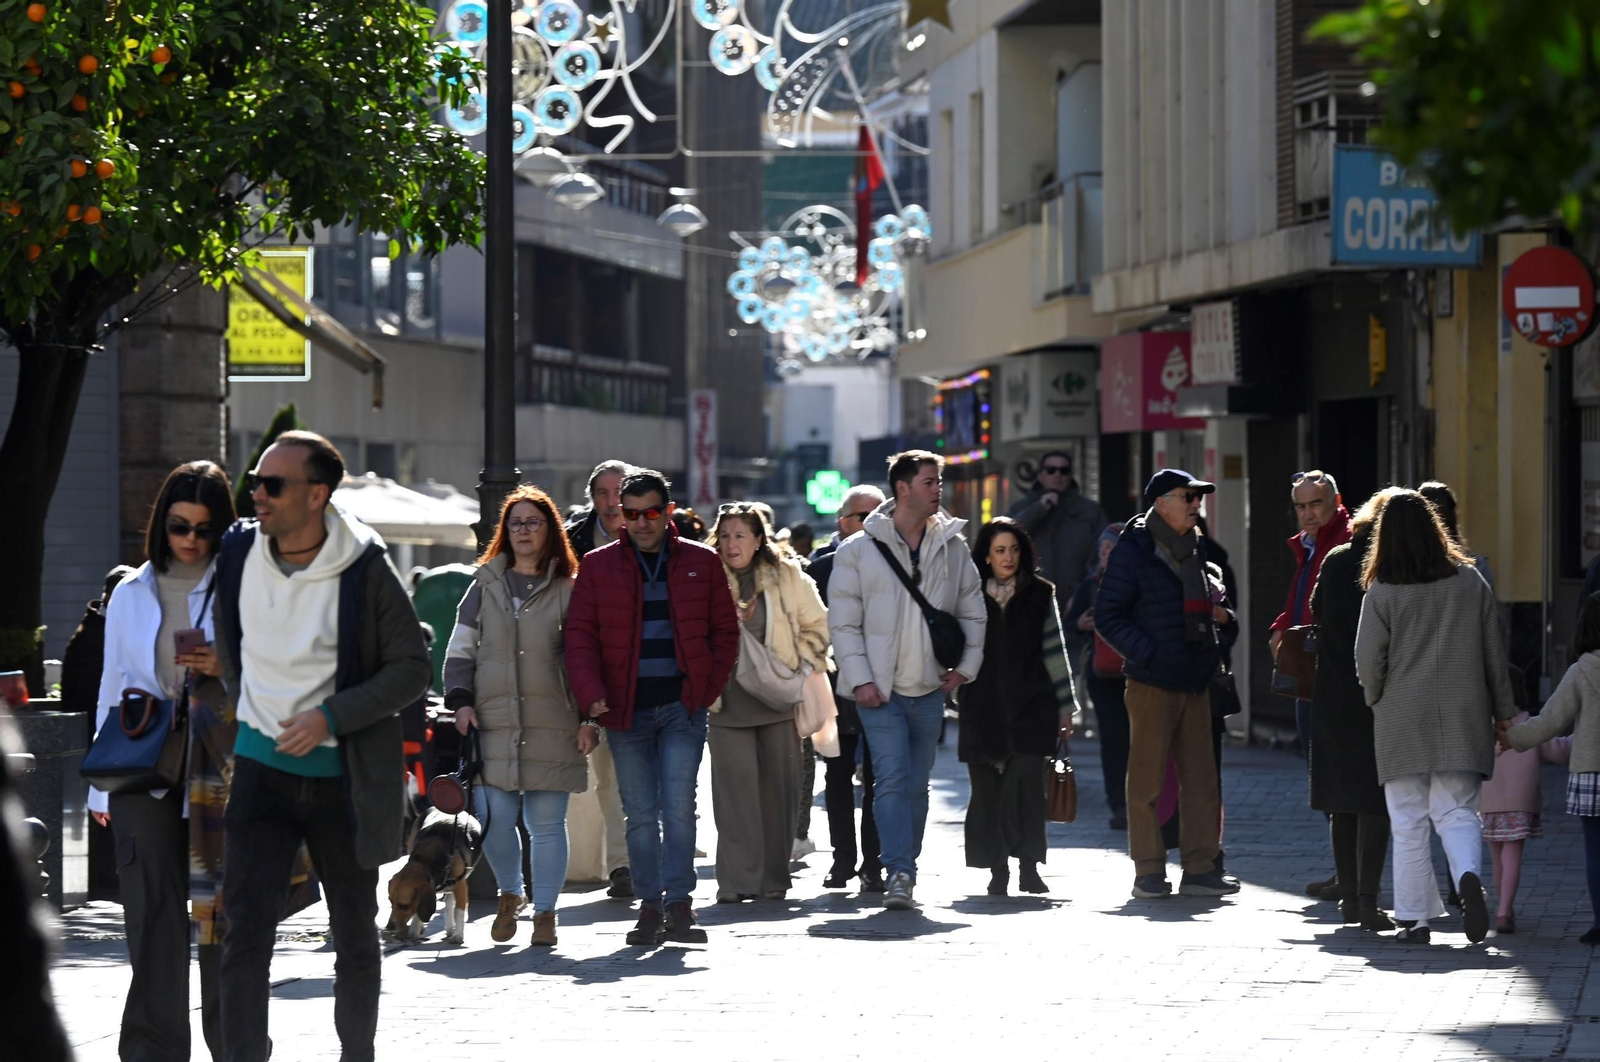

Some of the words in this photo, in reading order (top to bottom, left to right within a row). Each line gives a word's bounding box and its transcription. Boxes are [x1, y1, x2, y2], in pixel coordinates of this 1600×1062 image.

[237, 308, 275, 323] ORO
[231, 327, 246, 339] AL
[253, 327, 287, 339] PESO
